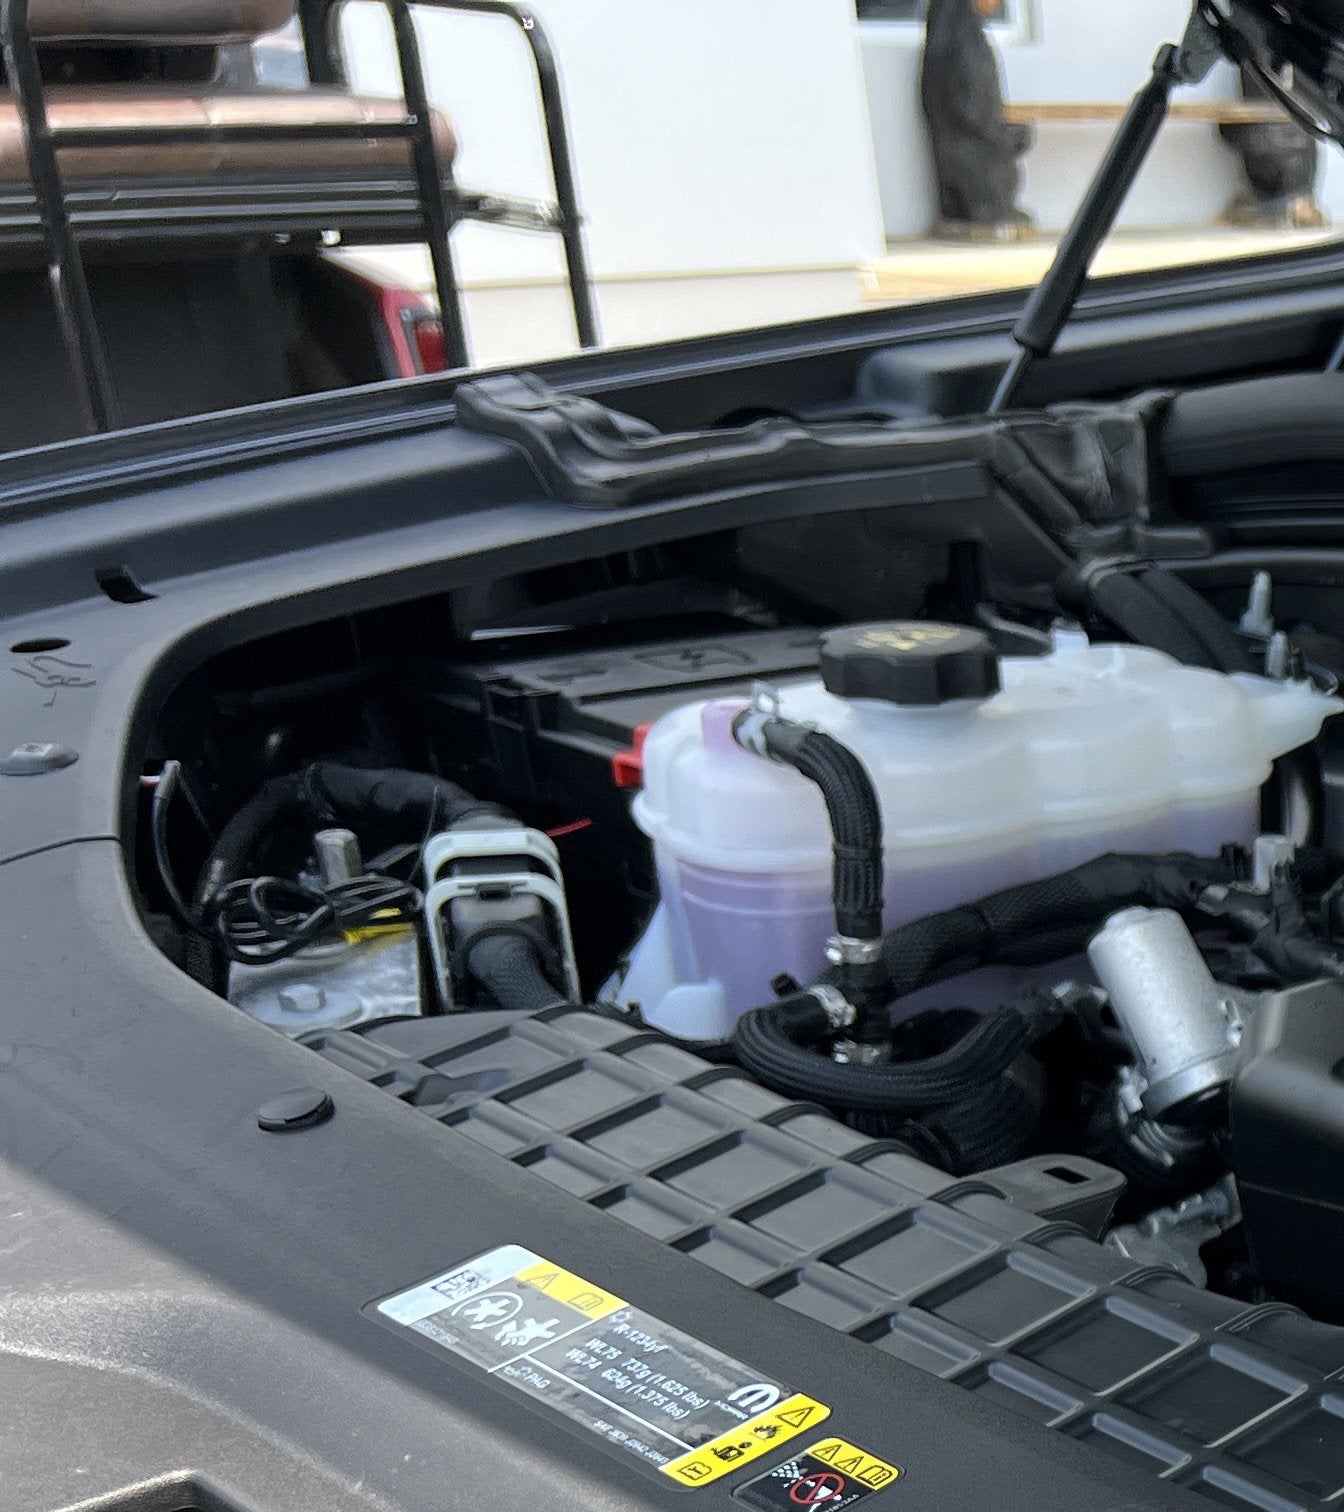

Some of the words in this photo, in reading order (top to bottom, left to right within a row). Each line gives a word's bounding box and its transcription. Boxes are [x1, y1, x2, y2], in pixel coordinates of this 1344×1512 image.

[612, 1322, 669, 1354] R-1234yf
[566, 1348, 602, 1370] WL74
[585, 1337, 623, 1360] WL75
[621, 1357, 650, 1380] 737g
